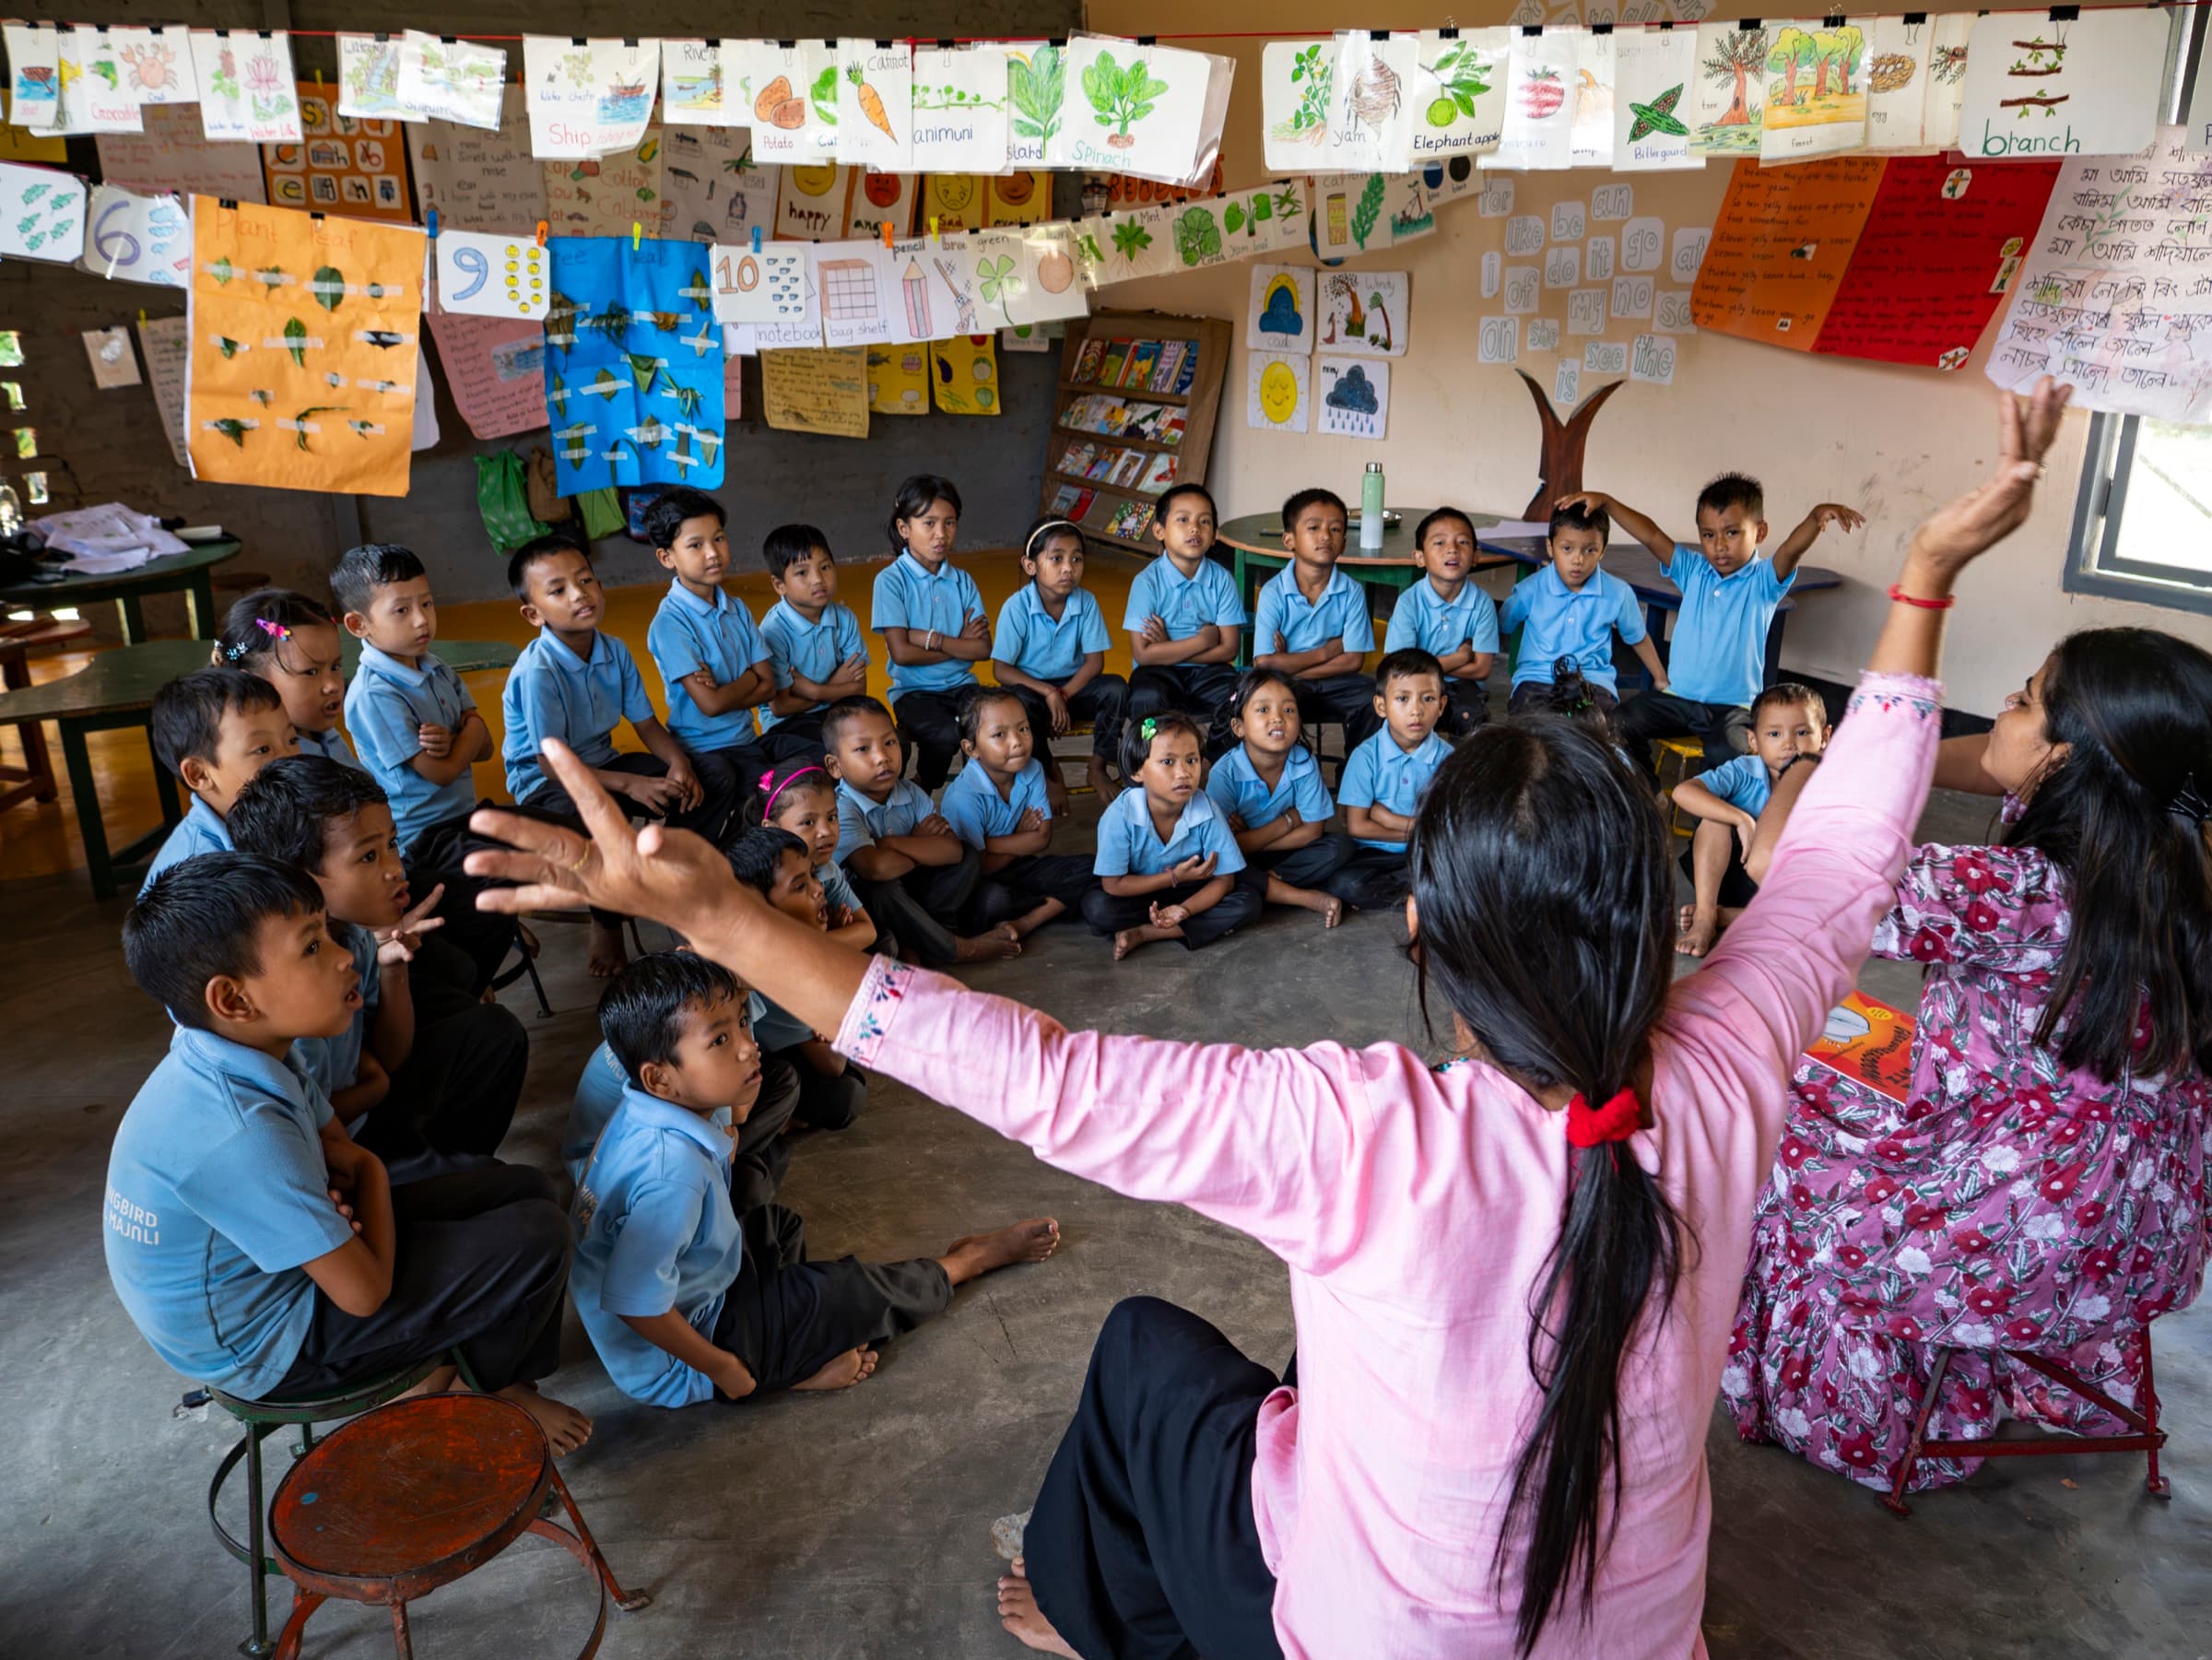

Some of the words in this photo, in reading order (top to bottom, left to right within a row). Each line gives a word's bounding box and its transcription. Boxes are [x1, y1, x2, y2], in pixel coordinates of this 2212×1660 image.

[1871, 111, 1888, 124] egg
[548, 123, 591, 148] Ship
[763, 135, 794, 149] Potato
[1413, 133, 1474, 154] Elephant
[1982, 118, 2080, 157] branch
[2080, 168, 2100, 182] মা
[2110, 165, 2149, 184] আমি
[790, 200, 831, 230] happy
[1593, 186, 1630, 218] an
[2126, 193, 2172, 210] আমি
[94, 200, 141, 265] 6
[977, 234, 1010, 253] green
[1506, 218, 1544, 253] like
[1627, 229, 1659, 269] go
[2047, 236, 2076, 257] মা
[2091, 239, 2139, 262] আমি
[453, 246, 488, 301] 9
[715, 254, 759, 295] 10
[1547, 249, 1576, 285] do
[1591, 241, 1610, 278] it
[1506, 270, 1538, 309] of
[1614, 279, 1652, 316] no
[1570, 290, 1606, 333] my
[758, 323, 823, 343] notebook
[830, 324, 854, 345] bag
[857, 319, 889, 336] shelf
[1480, 318, 1517, 362] on
[1529, 320, 1559, 347] she
[1634, 335, 1675, 378] the
[1557, 359, 1577, 403] is
